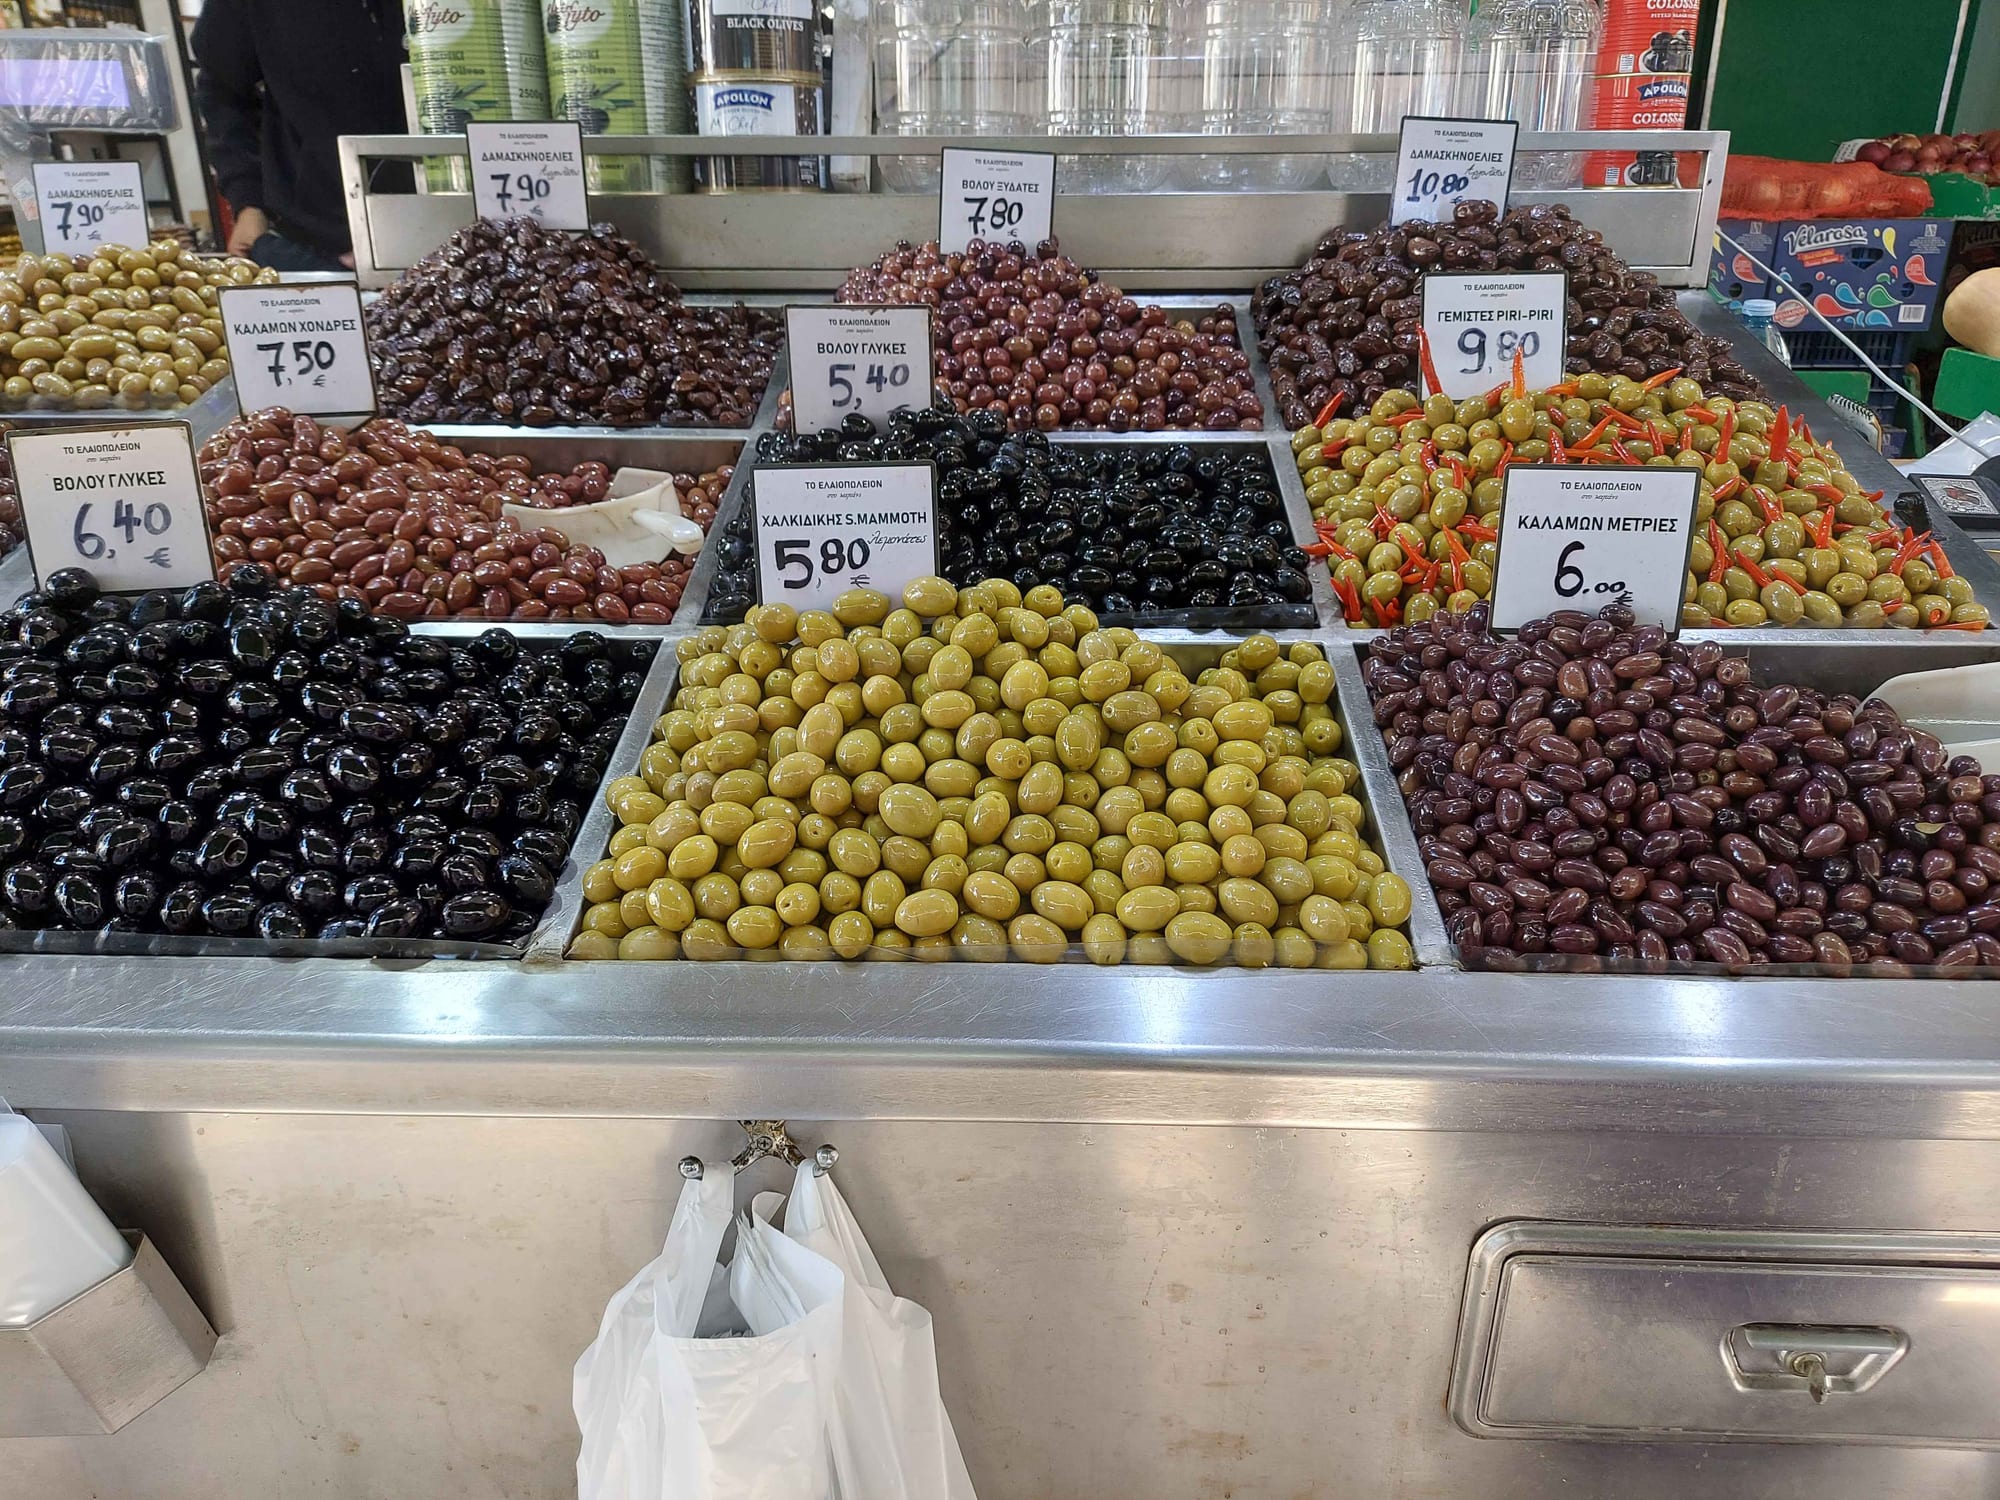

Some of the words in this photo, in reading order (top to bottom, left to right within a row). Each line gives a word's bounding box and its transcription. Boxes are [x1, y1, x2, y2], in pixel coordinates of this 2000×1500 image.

[727, 17, 765, 29] BLACK
[767, 19, 804, 32] OLIVES
[717, 92, 769, 107] APOLLON
[482, 152, 574, 161] ΔΑΜΑΣΚΗΝΟΕΛΙΕΣ
[1410, 149, 1503, 162] ΔΑΜΑΣΚΗΝΟΕΛΙΕΣ
[490, 173, 550, 213] 7,90
[962, 180, 995, 190] ΒΟΛΟΥ
[997, 182, 1040, 193] ΞΥΔΑΤΕΣ
[1406, 168, 1469, 202] 10,80
[47, 189, 134, 199] ΔΑΜΑΣΚΗΝΟΕΛΙΕΣ
[51, 201, 104, 240] 7,90
[964, 197, 1023, 237] 7,80
[1474, 283, 1525, 291] ΕΛΑΙΟΠΩΛΕΙΟΝ
[1437, 310, 1494, 322] ΓΕΜΙΣΤΕΣ
[1497, 309, 1553, 321] PIRI-PIRI
[234, 322, 297, 335] ΚΑΛΑΜΩΝ
[299, 319, 357, 333] ΧΟΝΔΡΕΣ
[817, 342, 859, 354] ΒΟΛΟΥ
[861, 343, 907, 355] ΓΛΥΚΕΣ
[1457, 327, 1540, 375] 9,80
[256, 340, 336, 387] 7,50
[828, 364, 910, 410] 5,40
[63, 446, 75, 455] ΤΟ
[76, 442, 141, 454] ΕΛΑΙΟΠΩΛΕΙΟΝ
[53, 474, 106, 492] ΒΟΛΟΥ
[109, 471, 167, 488] ΓΛΥΚΕΣ
[805, 481, 816, 490] ΤΟ
[818, 480, 883, 489] ΕΛΑΙΟΠΩΛΕΙΟΝ
[1560, 481, 1572, 490] ΤΟ
[1574, 482, 1642, 491] ΕΛΑΙΟΠΩΛΕΙΟΝ
[762, 513, 843, 527] ΧΑΛΚΙΔΙΚΗΣ
[845, 511, 927, 526] S.MAMMOTH
[1518, 515, 1604, 531] ΚΑΛΑΜΩΝ
[1607, 517, 1678, 532] ΜΕΤΡΙΕΣ
[73, 499, 172, 560] 6,40
[144, 547, 173, 569] €
[774, 537, 871, 591] 5,80
[1554, 540, 1626, 598] 6.00
